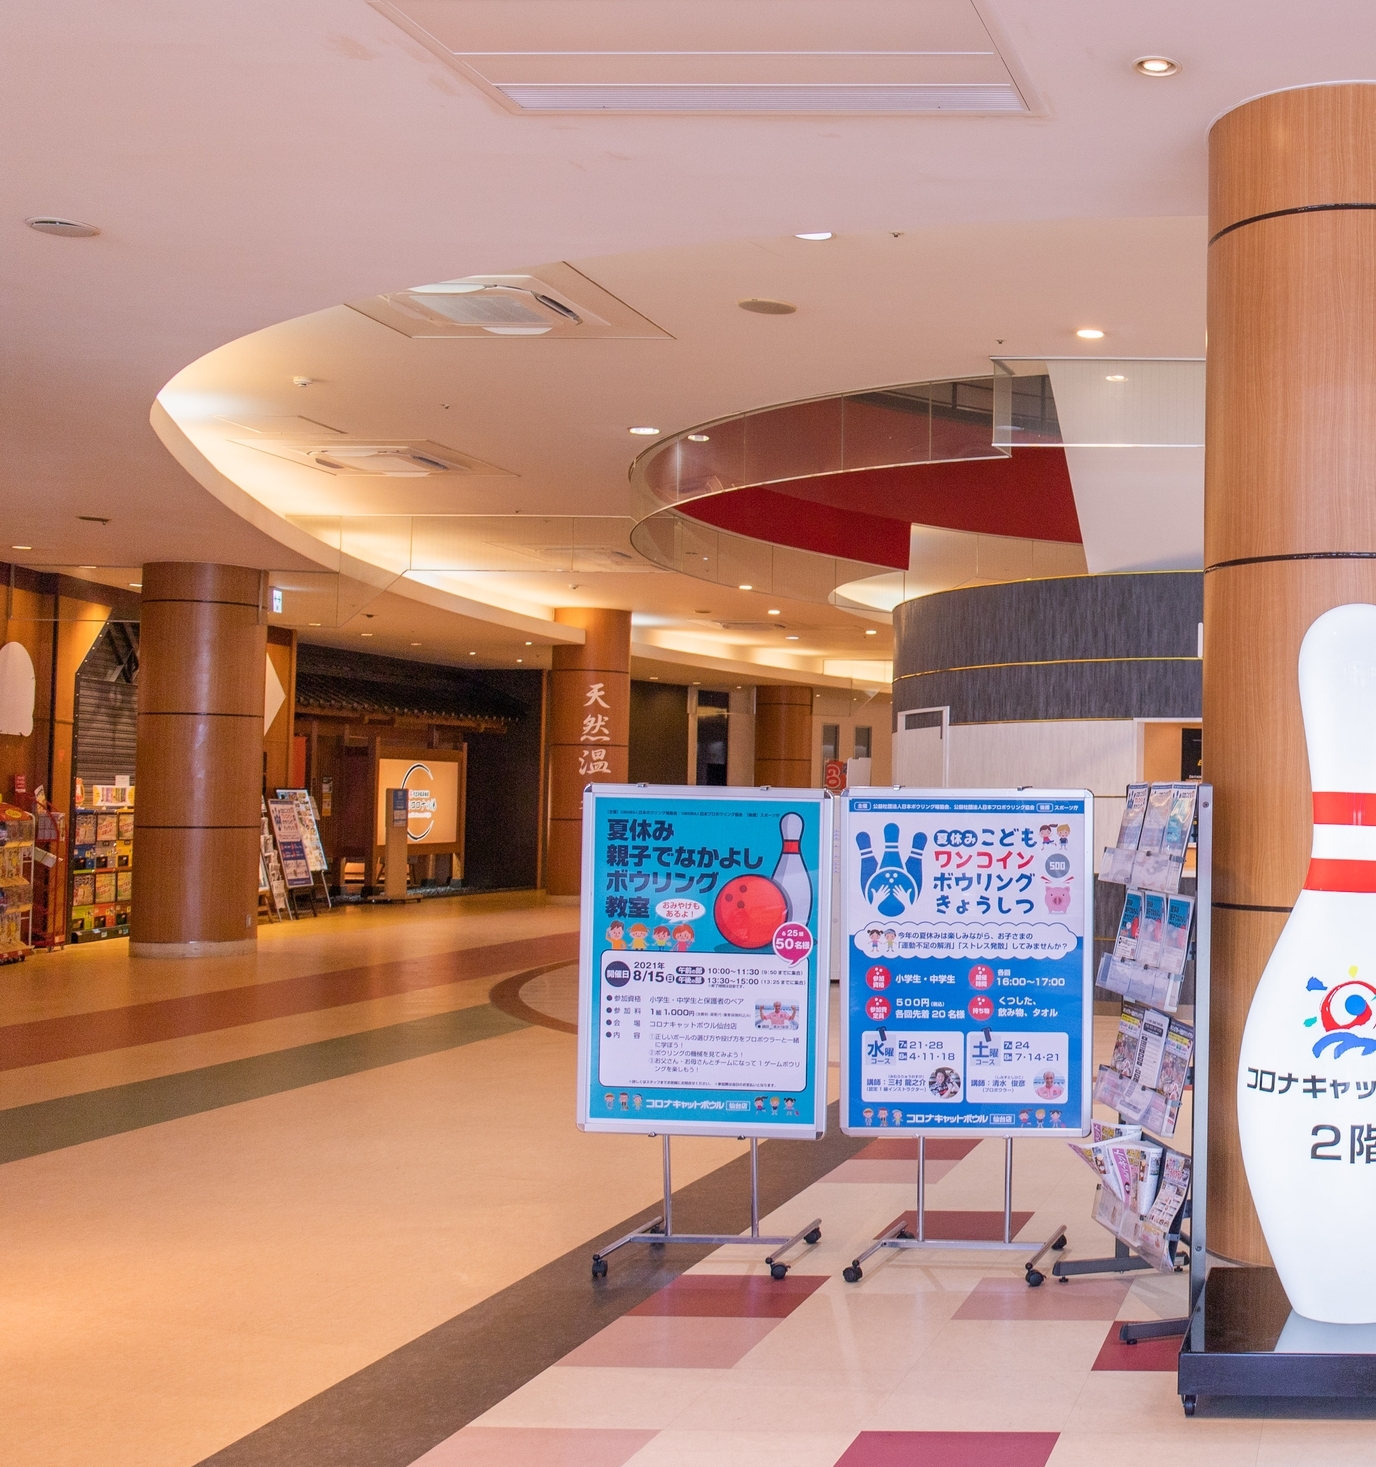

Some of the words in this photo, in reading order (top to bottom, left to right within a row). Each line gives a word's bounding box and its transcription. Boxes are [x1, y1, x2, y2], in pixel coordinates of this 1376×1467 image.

[579, 683, 611, 809] 天然温
[607, 818, 674, 842] 夏休み
[936, 831, 977, 845] 夏休み
[981, 828, 1038, 848] こども
[606, 845, 763, 869] 親子でなかよし
[934, 850, 1035, 870] ワンコイン
[1049, 861, 1066, 871] 500
[606, 871, 719, 893] ボウリング
[933, 872, 1036, 893] ボウリング
[605, 896, 650, 919] 教室
[662, 901, 700, 910] おみやげも
[935, 895, 1035, 915] きょうしつ
[665, 910, 694, 918] あるよ!
[898, 931, 1033, 940] 今年の夏休みは楽しみながら、お子さまの
[775, 938, 810, 950] 50名様
[634, 962, 665, 970] 2021年
[606, 969, 629, 979] 開催日
[633, 970, 664, 982] 8/15
[895, 974, 956, 984] 小学生・中学生
[997, 977, 1066, 986] 16:00~17:00
[896, 998, 930, 1007] 500円
[999, 996, 1037, 1006] くつした、
[931, 1010, 946, 1018] 20
[998, 1008, 1058, 1017] 飲み物、タオル
[867, 1040, 894, 1058] 水曜
[972, 1041, 999, 1058] 土曜
[1015, 1041, 1030, 1049] 24
[646, 1099, 725, 1110] コロナキャットボウル
[906, 1114, 989, 1123] コロナキャットボウル
